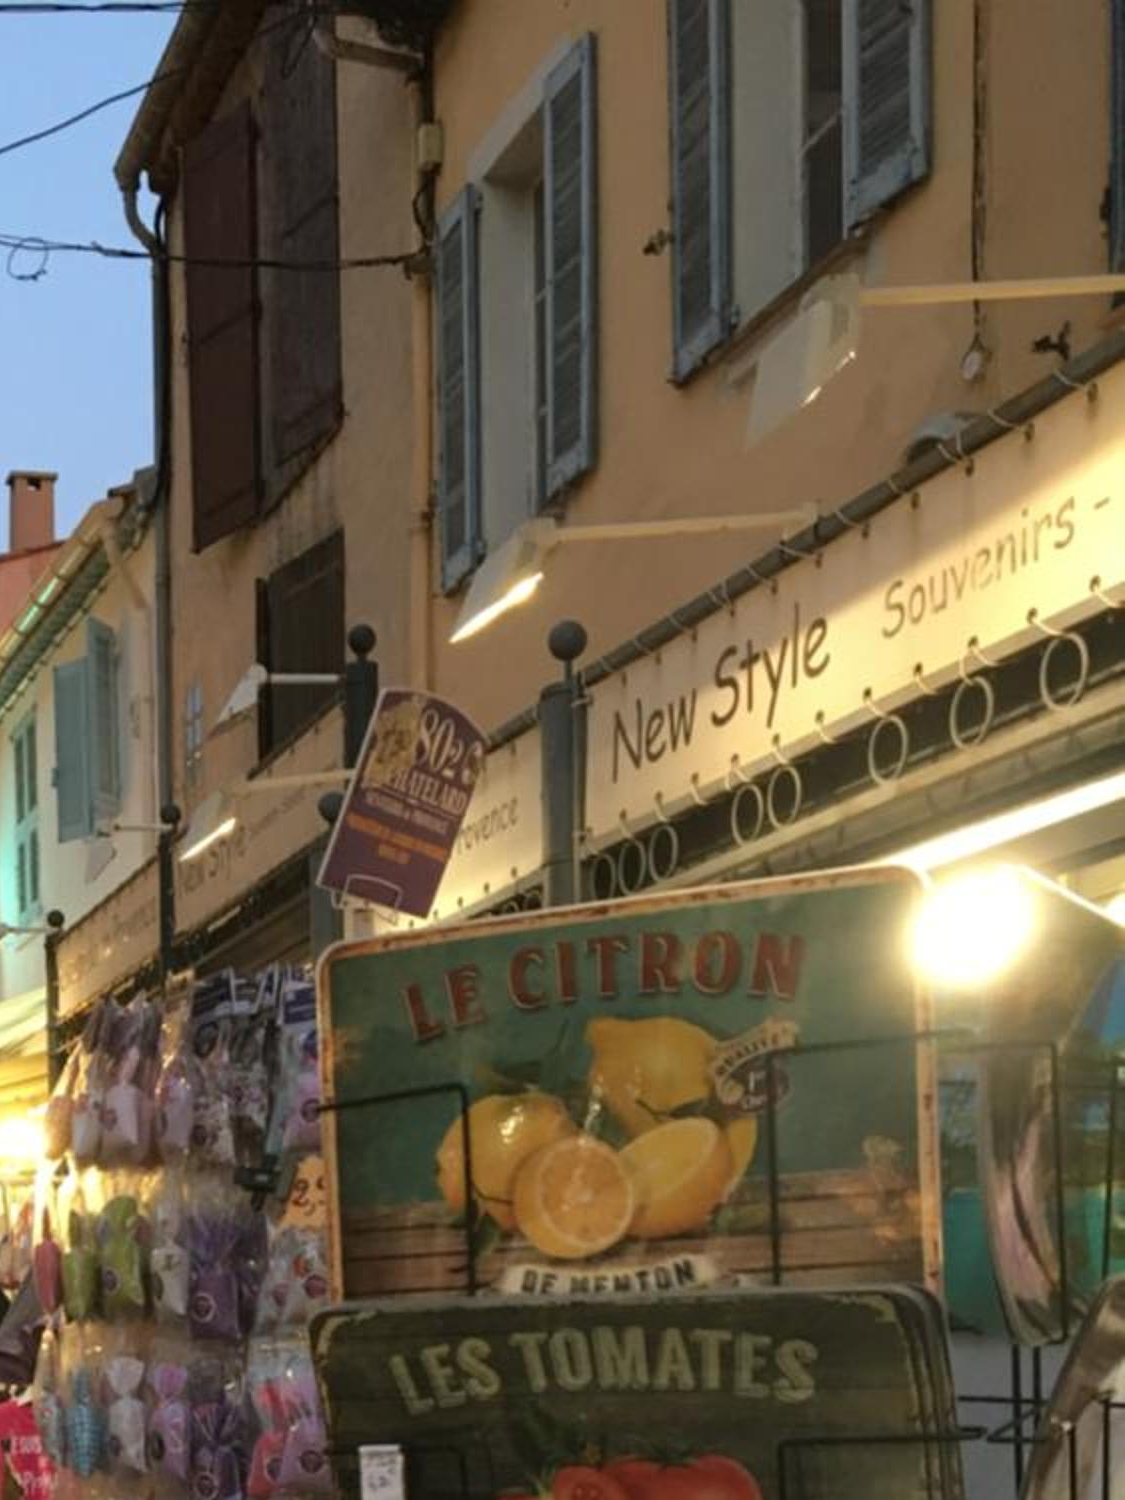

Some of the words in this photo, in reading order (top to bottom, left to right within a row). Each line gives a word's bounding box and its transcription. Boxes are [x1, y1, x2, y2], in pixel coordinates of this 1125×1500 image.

[612, 688, 697, 784] New
[712, 602, 831, 730] Style
[881, 496, 1076, 639] Souvenirs
[457, 797, 518, 856] rovence
[400, 962, 489, 1045] LE
[509, 928, 808, 1014] CITRON
[519, 1268, 559, 1294] DE
[390, 1337, 500, 1415] LES
[509, 1326, 820, 1402] TOMATES
